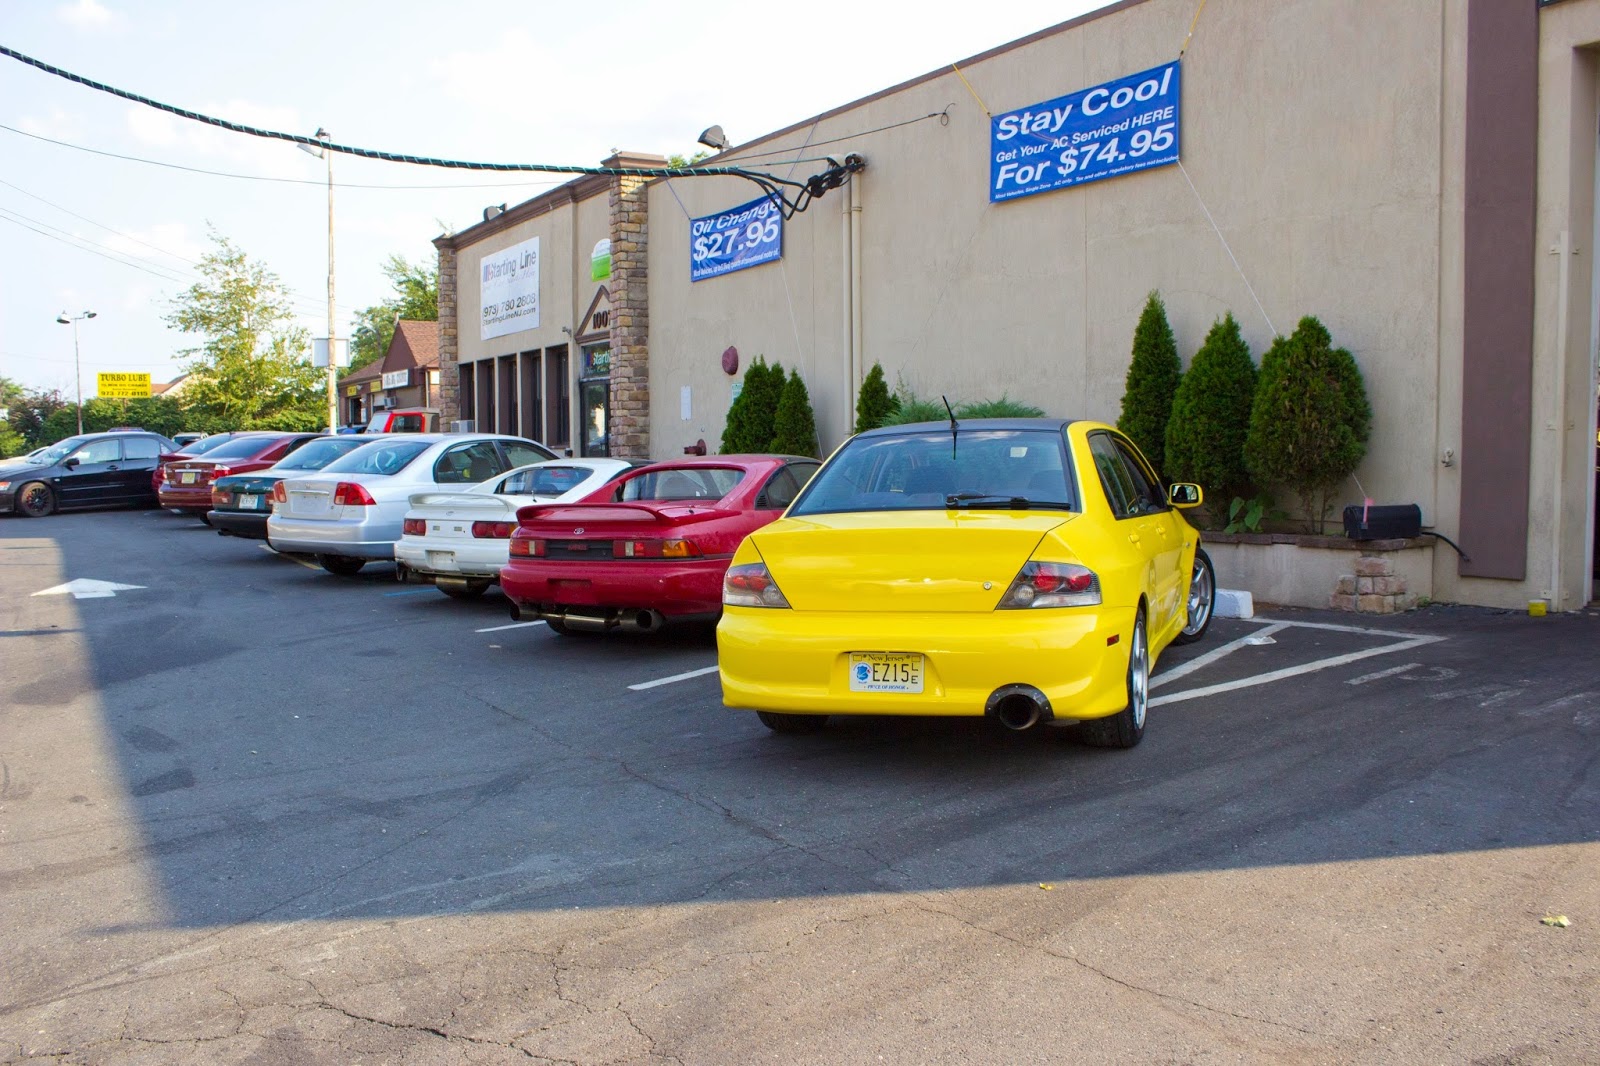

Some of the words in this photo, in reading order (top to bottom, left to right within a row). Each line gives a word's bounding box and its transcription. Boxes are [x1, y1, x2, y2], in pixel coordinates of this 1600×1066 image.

[996, 104, 1073, 141] Stay
[1081, 67, 1173, 116] Cool
[996, 149, 1017, 164] Get
[1020, 142, 1048, 158] Your
[1050, 136, 1069, 151] AC
[1072, 119, 1129, 145] Serviced
[1131, 106, 1175, 129] HERE
[995, 160, 1050, 190] For
[1058, 122, 1175, 177] $74.95
[1109, 164, 1134, 176] regulatory
[693, 219, 714, 236] Oil
[716, 198, 781, 230] Change
[693, 215, 780, 264] $27.95
[489, 258, 516, 280] Starting
[520, 250, 536, 268] Line
[502, 299, 515, 312] 780
[516, 293, 536, 308] 2808
[482, 307, 536, 326] StartingLineNJ.com
[100, 374, 126, 382] TURBO
[128, 374, 148, 382] LUBE
[884, 654, 905, 662] Jersey
[872, 663, 909, 682] EZ15
